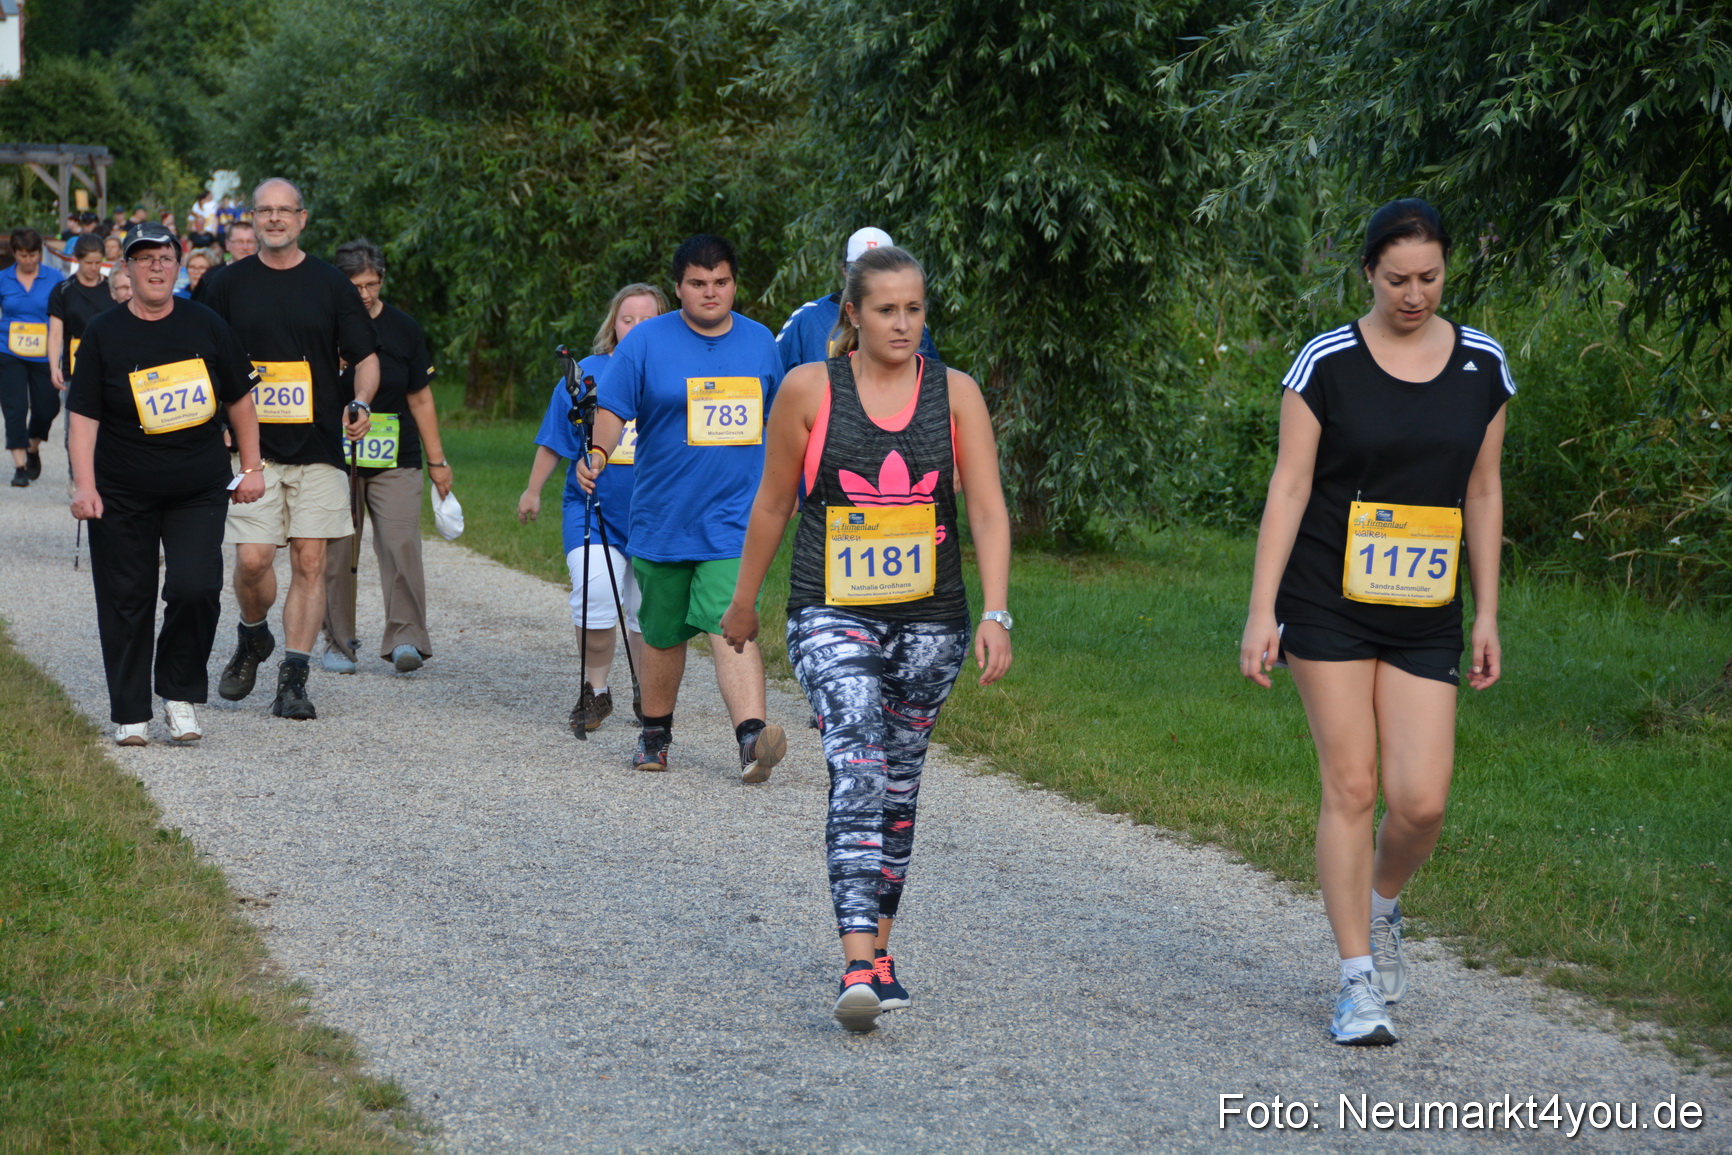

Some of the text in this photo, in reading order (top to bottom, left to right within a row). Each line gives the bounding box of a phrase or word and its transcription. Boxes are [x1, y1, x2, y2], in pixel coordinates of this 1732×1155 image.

[17, 336, 39, 347] 754
[145, 385, 207, 416] 1274
[250, 387, 305, 406] 1260
[703, 404, 748, 427] 783
[841, 522, 880, 531] firmenlauf
[1367, 518, 1408, 529] firmenlauf
[831, 533, 862, 542] walken
[1354, 529, 1387, 539] walken
[838, 544, 921, 578] 1181
[1359, 543, 1449, 580] 1175
[879, 582, 912, 590] Großhans
[1369, 582, 1431, 592] Sandra Sammüller
